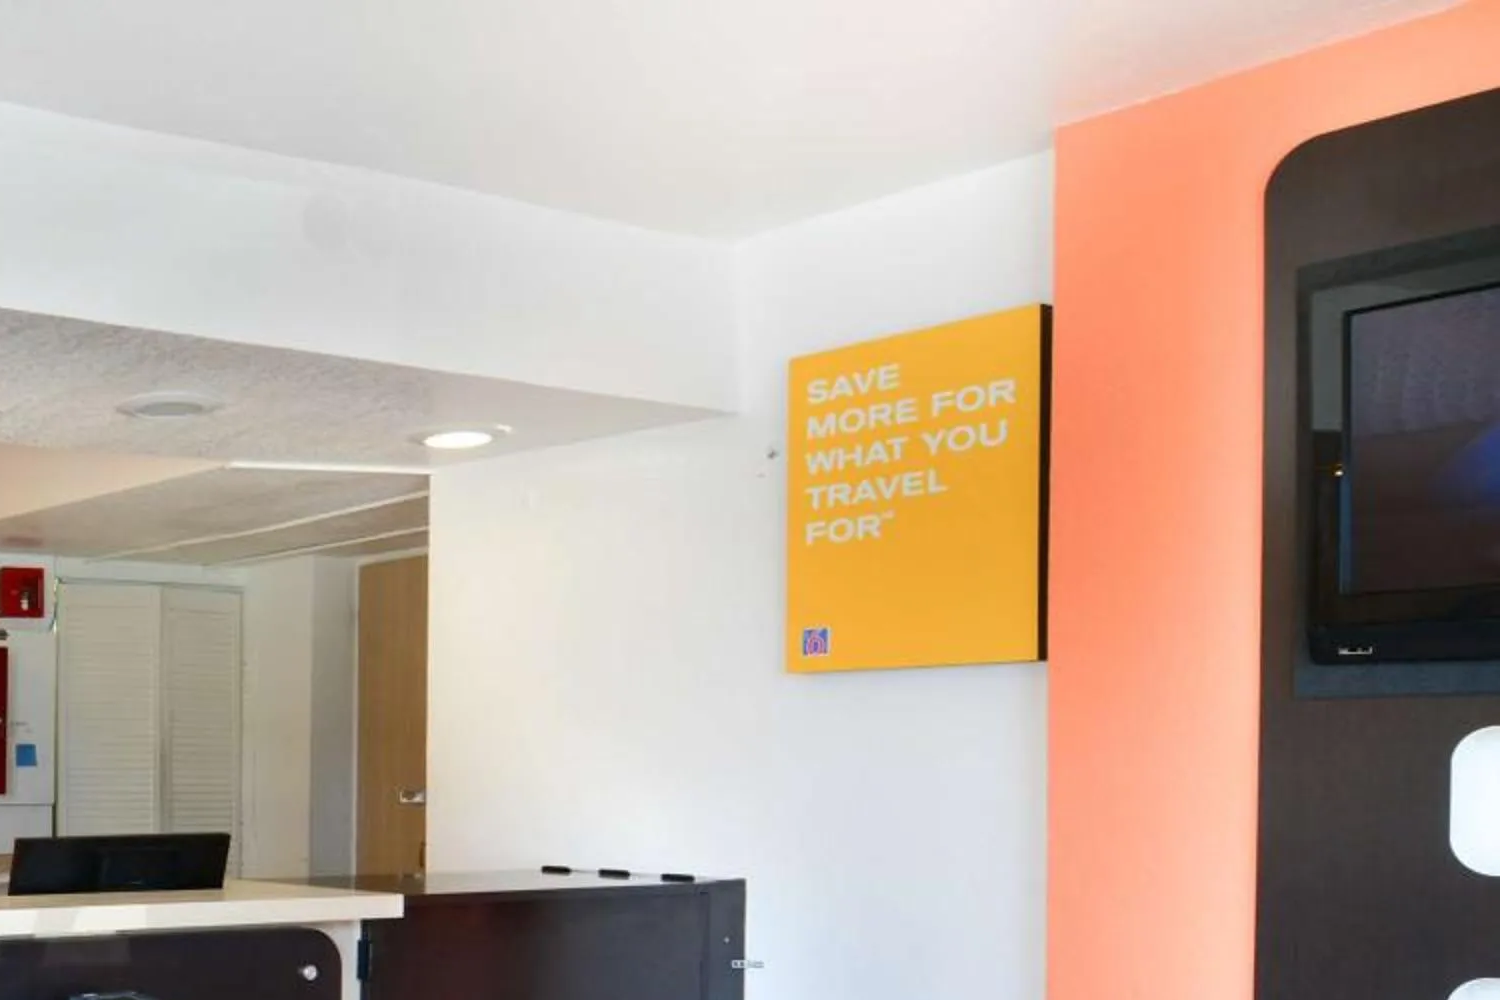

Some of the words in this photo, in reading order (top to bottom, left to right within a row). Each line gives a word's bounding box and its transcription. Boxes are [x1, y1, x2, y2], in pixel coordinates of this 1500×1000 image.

[806, 363, 900, 404] SAVE
[806, 397, 918, 439] MORE
[931, 378, 1017, 417] FOR
[807, 438, 906, 474] WHAT
[921, 419, 1009, 456] YOU
[807, 469, 946, 510] TRAVEL
